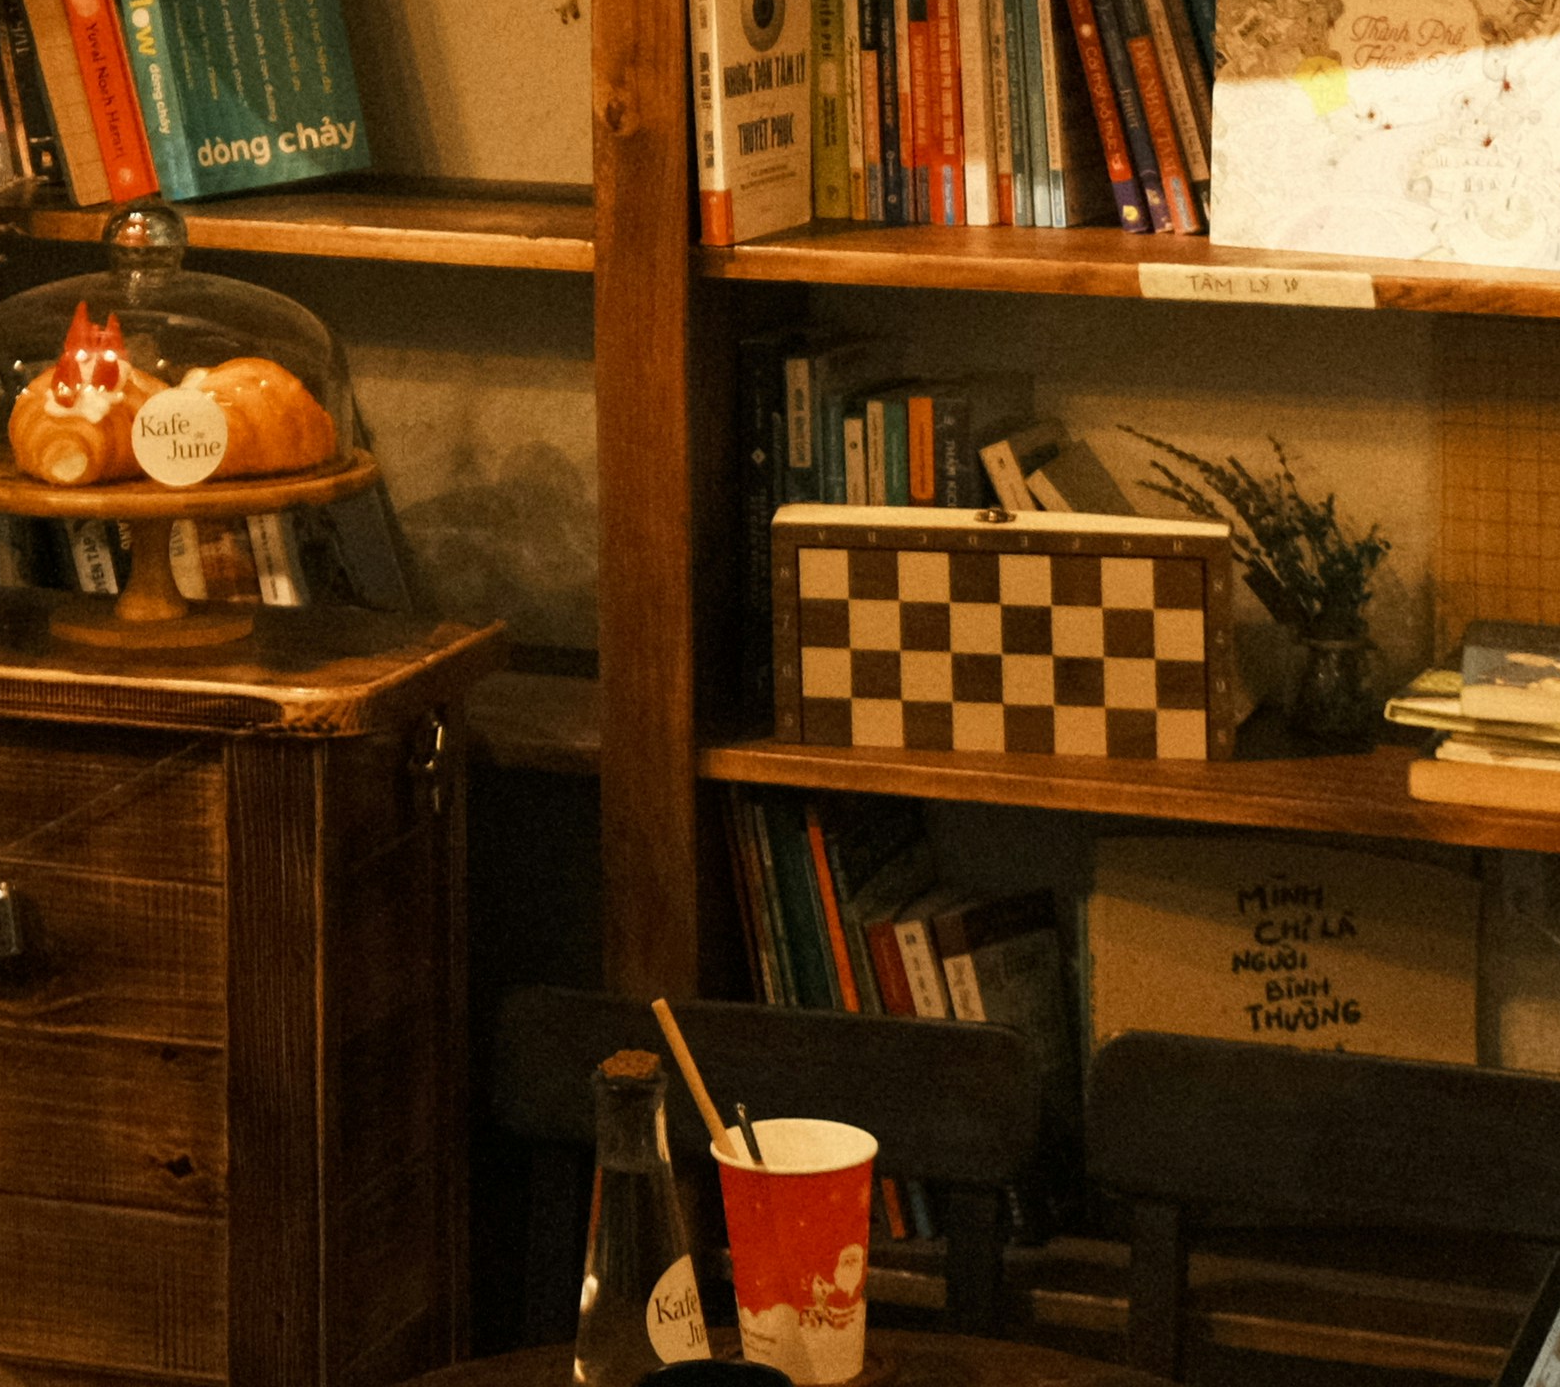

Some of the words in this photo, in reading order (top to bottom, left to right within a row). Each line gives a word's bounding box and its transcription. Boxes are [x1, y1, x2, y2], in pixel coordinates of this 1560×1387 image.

[81, 21, 105, 64] Yuval
[197, 133, 273, 167] dòng
[277, 114, 357, 155] chảy
[1185, 271, 1233, 294] TÂM
[138, 414, 191, 437] Kafe
[166, 438, 222, 462] June
[1236, 876, 1324, 914] MÌNH
[1320, 911, 1358, 939] LÀ
[1244, 998, 1362, 1033] THƯỜNG
[654, 1286, 698, 1325] Kafe
